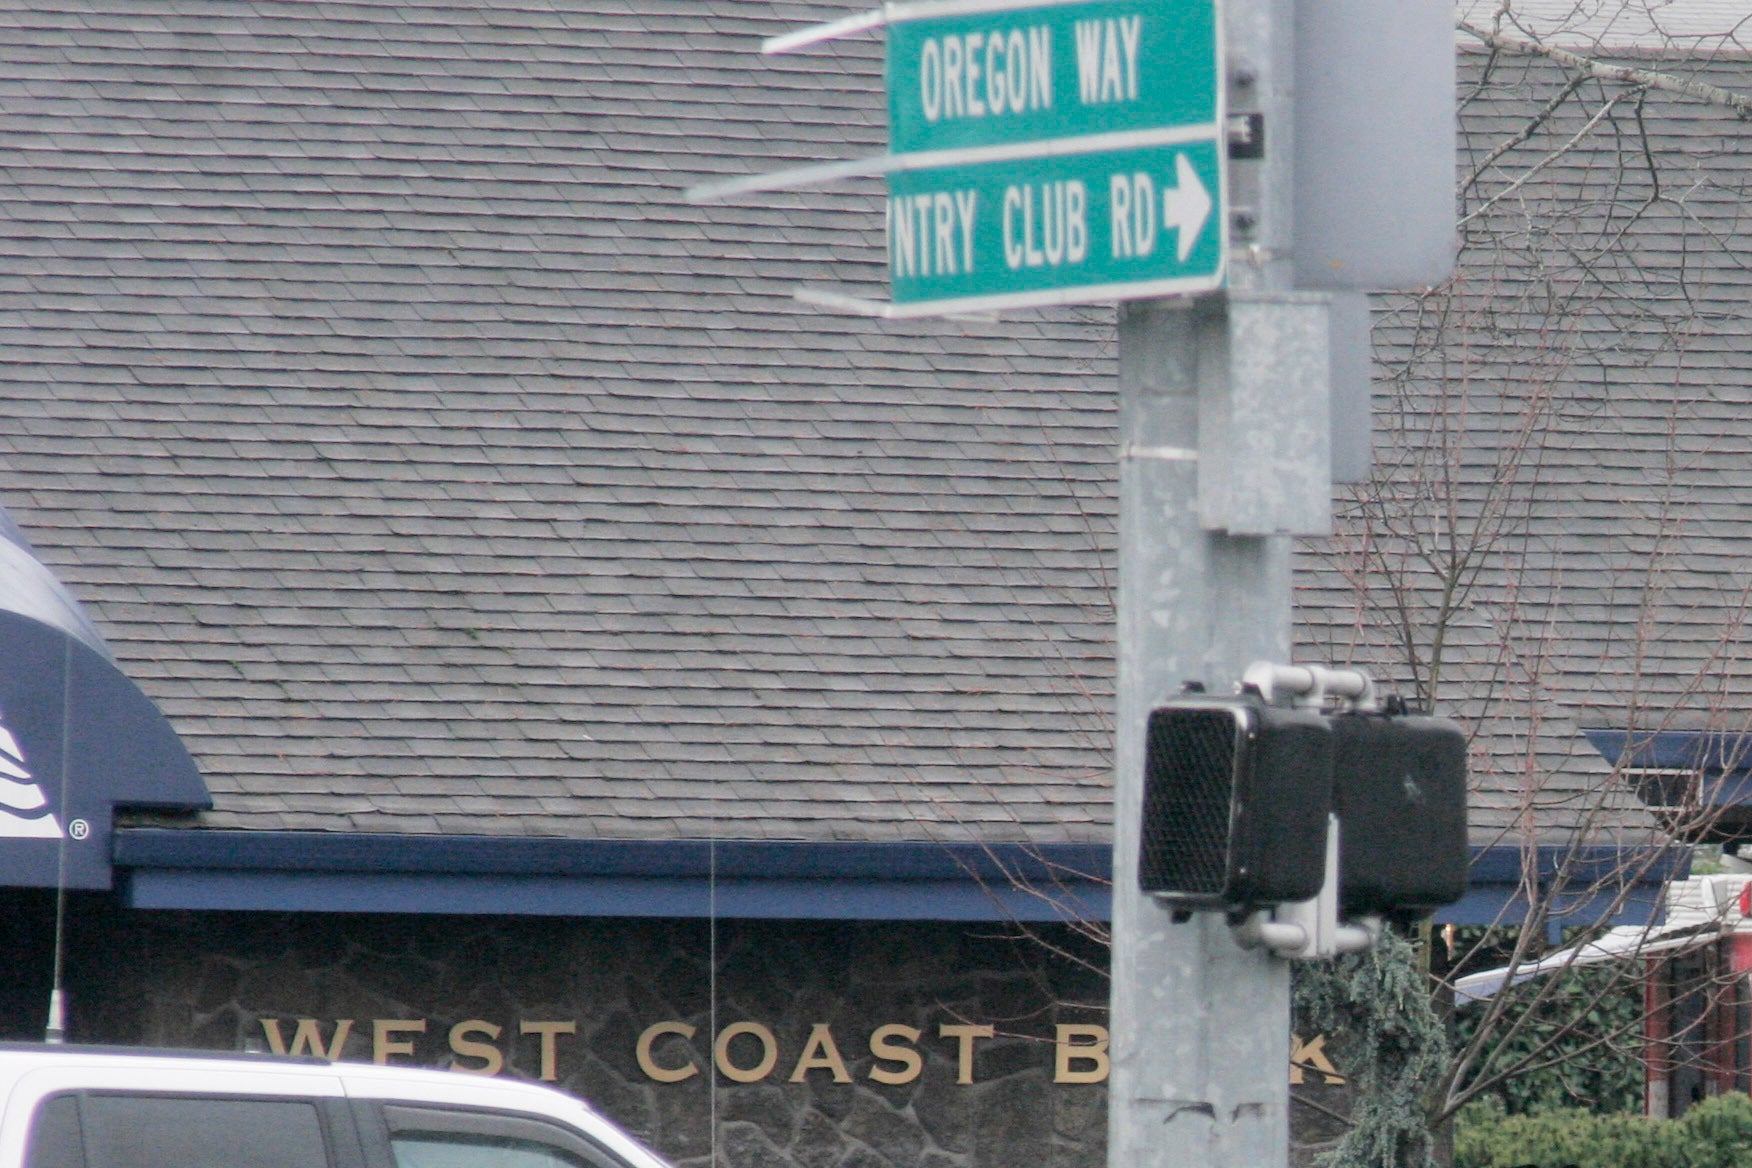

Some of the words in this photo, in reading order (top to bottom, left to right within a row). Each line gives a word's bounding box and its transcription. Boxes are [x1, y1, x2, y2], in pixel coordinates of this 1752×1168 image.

[919, 24, 1053, 121] OREGON
[1075, 14, 1142, 104] WAY
[1001, 178, 1088, 270] CLUB
[1109, 171, 1156, 259] RD
[258, 1017, 577, 1083] WEST
[635, 1020, 997, 1085] COAST
[1053, 1023, 1346, 1086] BK
